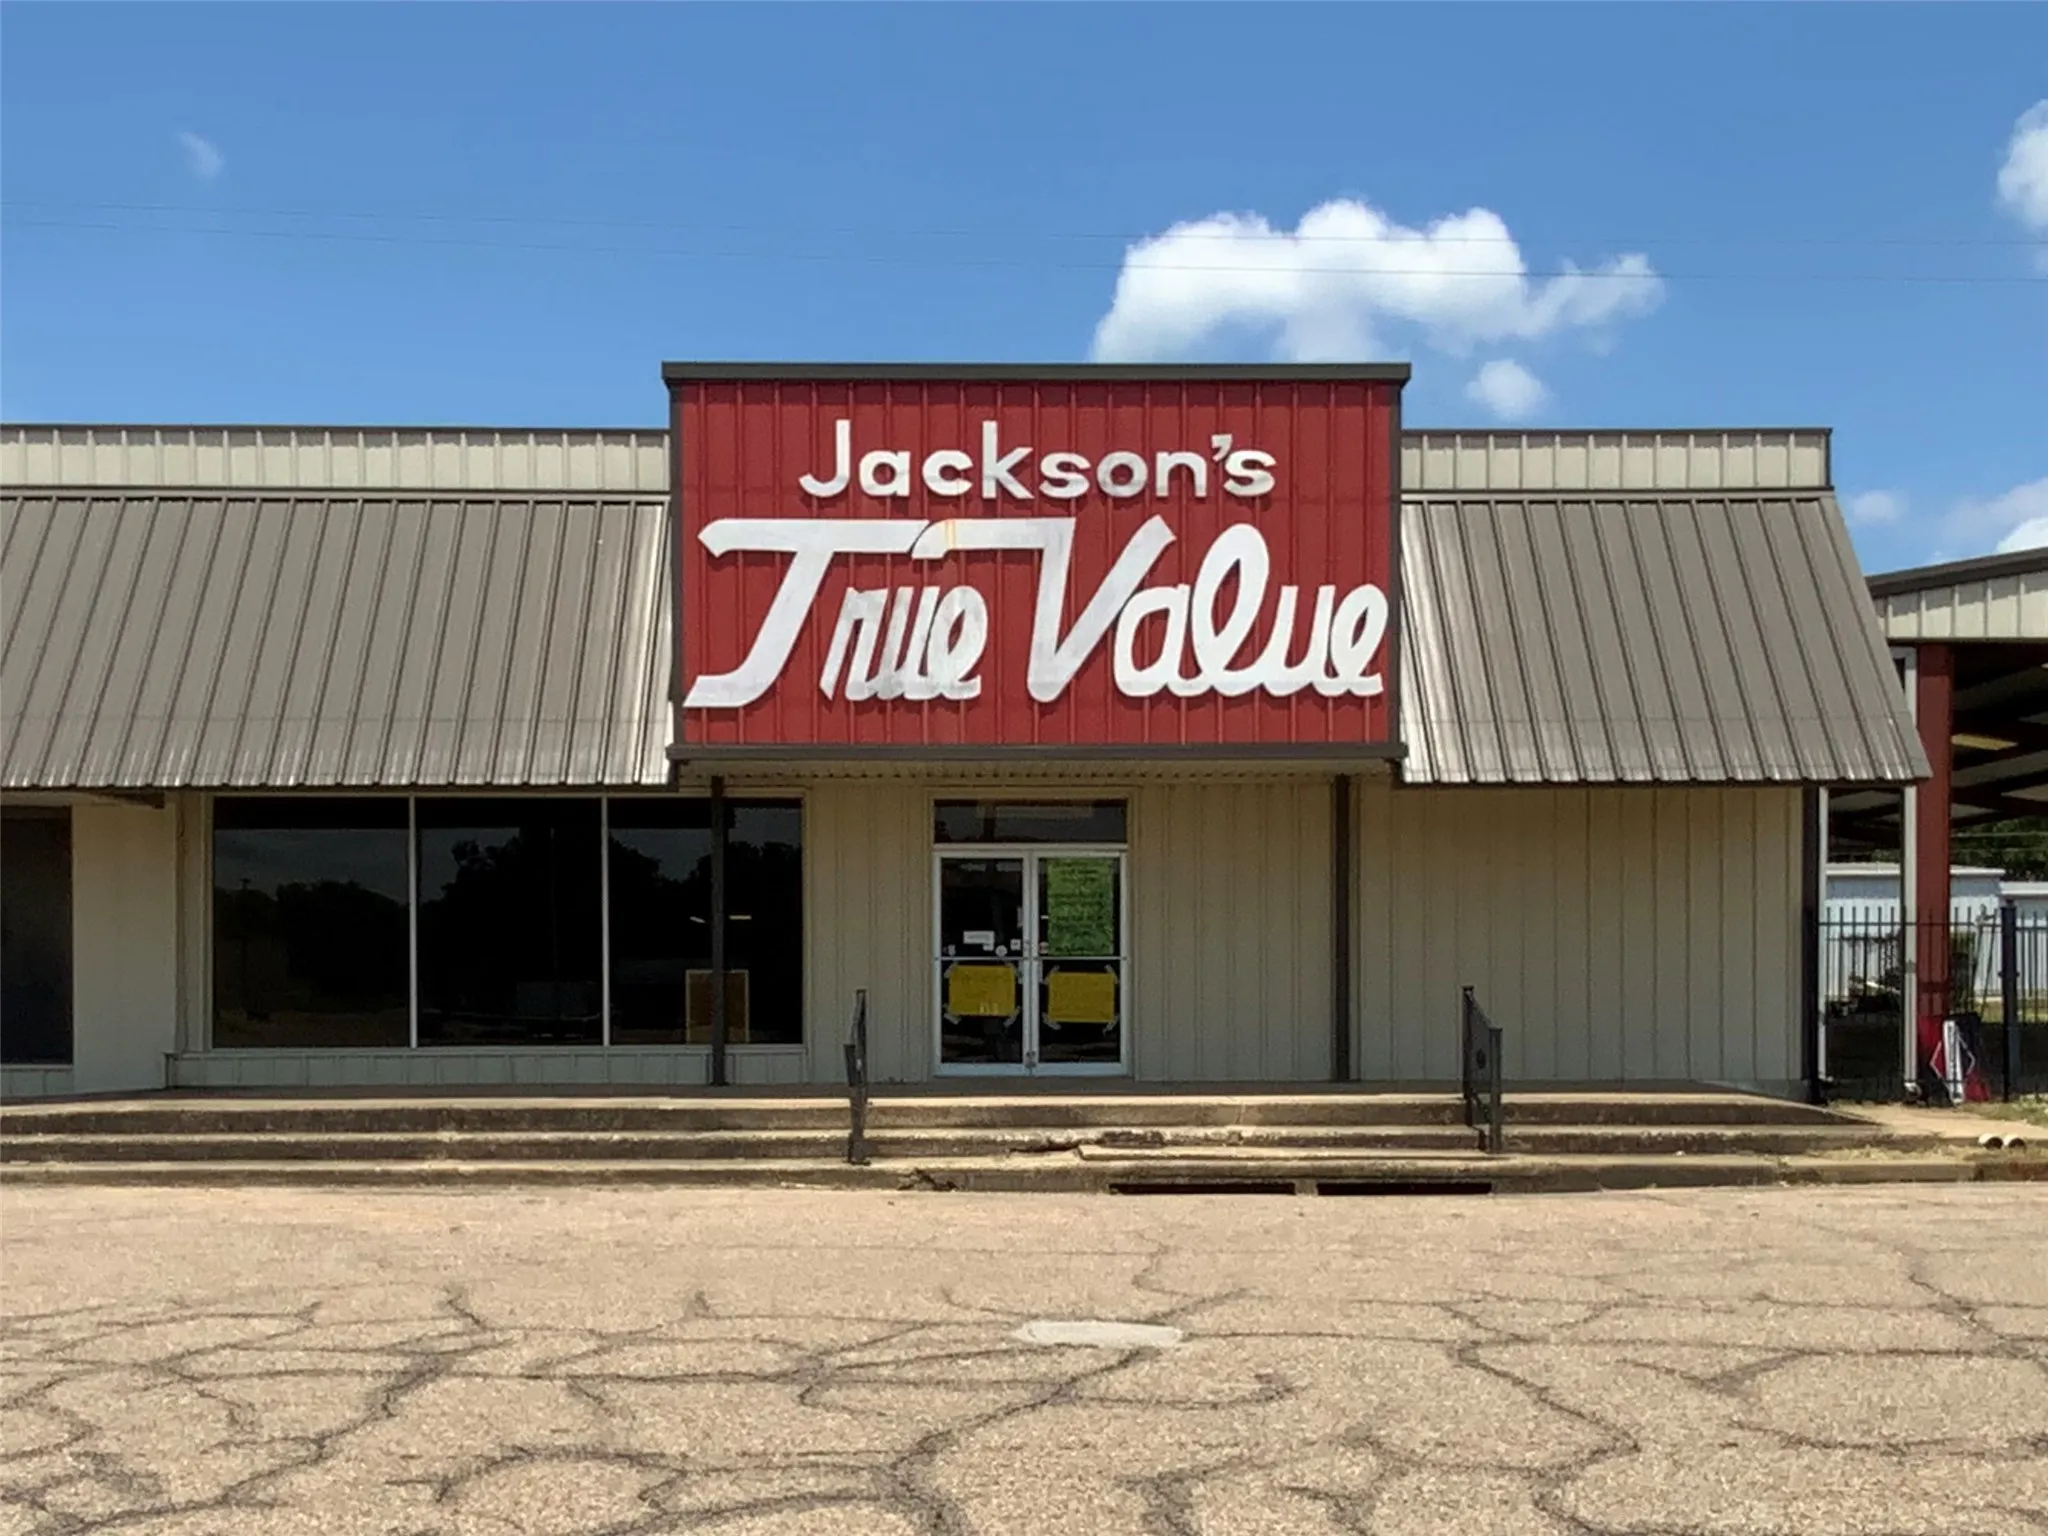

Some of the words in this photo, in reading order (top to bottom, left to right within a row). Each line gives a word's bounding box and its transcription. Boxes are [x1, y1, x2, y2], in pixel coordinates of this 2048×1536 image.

[799, 419, 1276, 498] Jackson's
[683, 517, 988, 708] True
[912, 515, 1388, 703] Value
